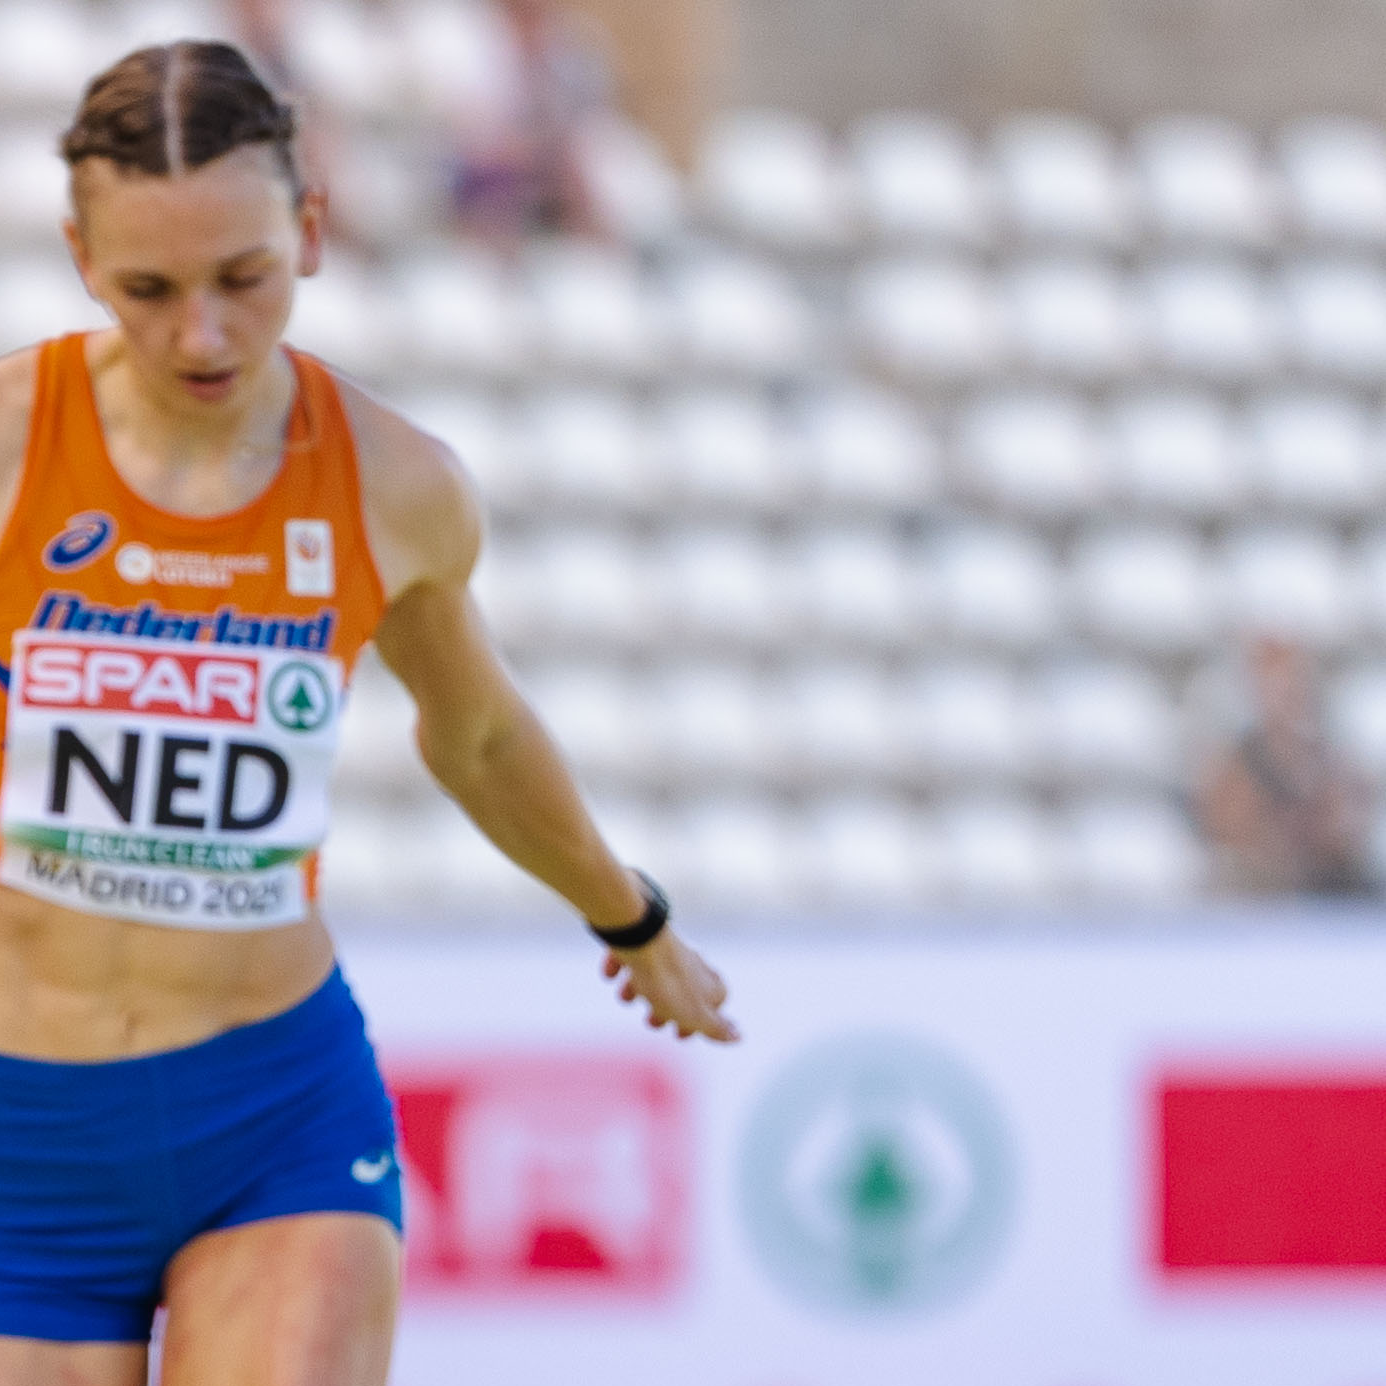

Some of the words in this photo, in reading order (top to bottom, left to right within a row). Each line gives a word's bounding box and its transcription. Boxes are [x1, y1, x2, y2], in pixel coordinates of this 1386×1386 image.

[27, 648, 254, 719] SPAR
[47, 727, 291, 832] NED
[28, 850, 192, 907] MADRID
